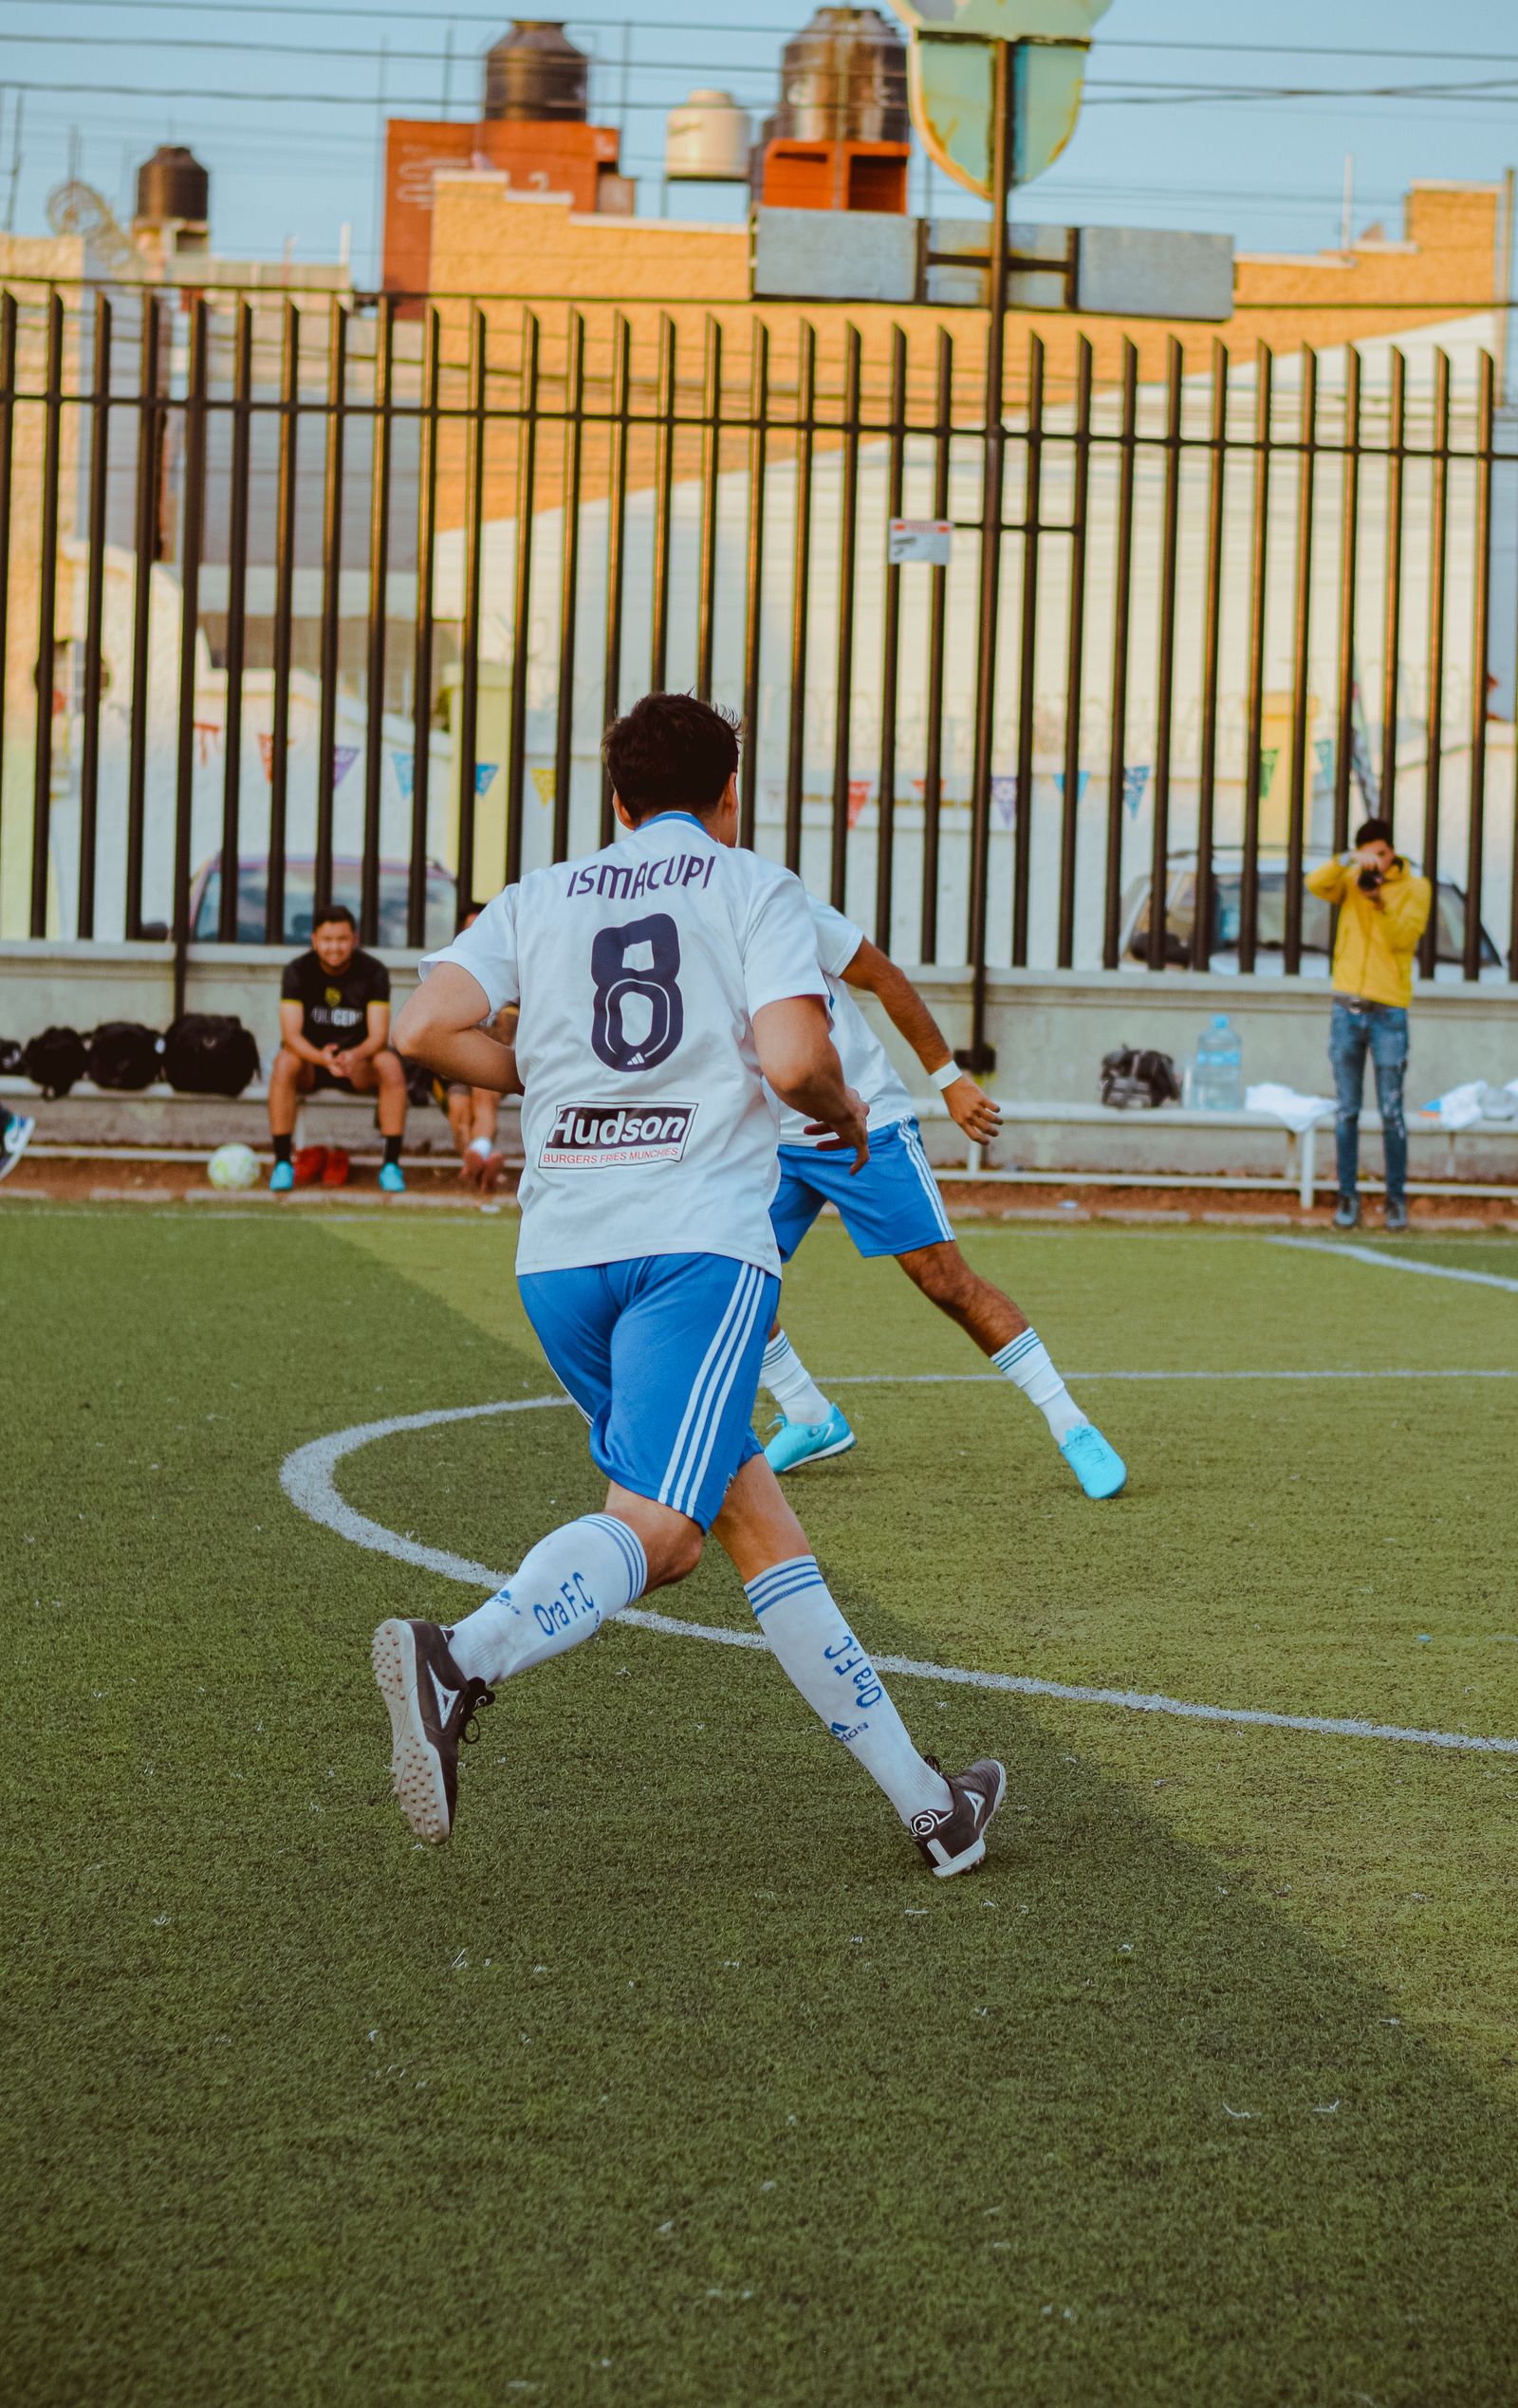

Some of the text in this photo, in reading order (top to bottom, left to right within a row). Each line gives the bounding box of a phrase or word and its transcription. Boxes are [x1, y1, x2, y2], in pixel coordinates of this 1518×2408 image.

[566, 854, 716, 899] ISMACUPI
[591, 912, 684, 1072] 8
[547, 1110, 686, 1145] Hudson
[543, 1146, 678, 1165] BURGERS FRIES MUNCHIES
[532, 1600, 570, 1637] Ora
[853, 1666, 882, 1709] Ora
